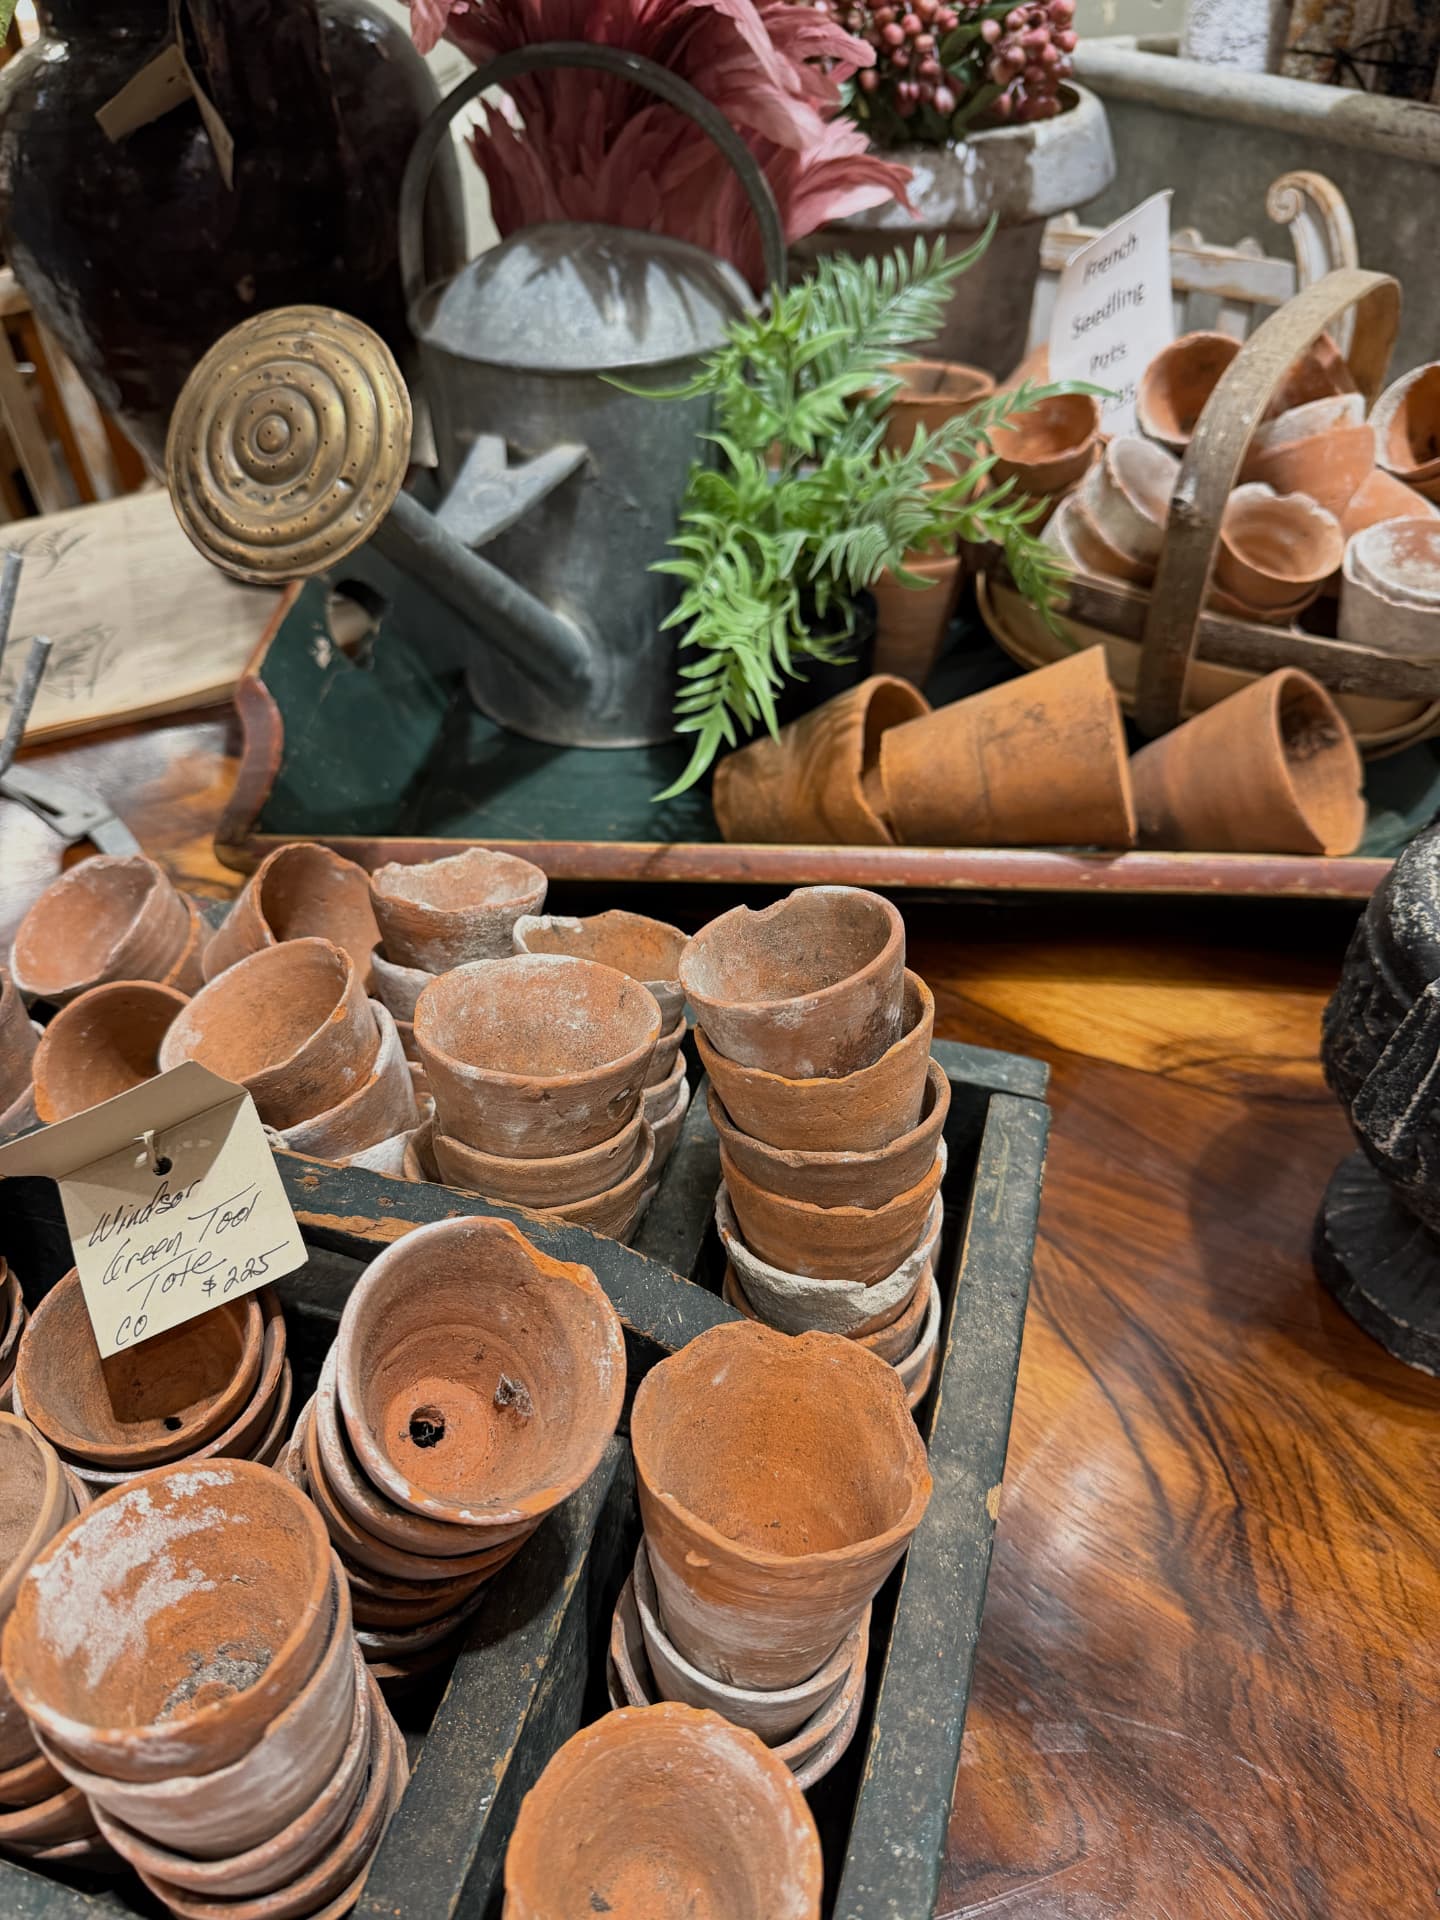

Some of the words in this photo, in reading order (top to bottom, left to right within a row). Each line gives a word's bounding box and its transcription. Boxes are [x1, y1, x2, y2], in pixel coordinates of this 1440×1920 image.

[1083, 232, 1138, 282] French
[1071, 282, 1145, 339] Seedling
[88, 1180, 202, 1248] Windsor
[102, 1232, 183, 1286] Green
[187, 1182, 263, 1243] Tool
[127, 1248, 227, 1310] Tote
[201, 1241, 290, 1298] $225
